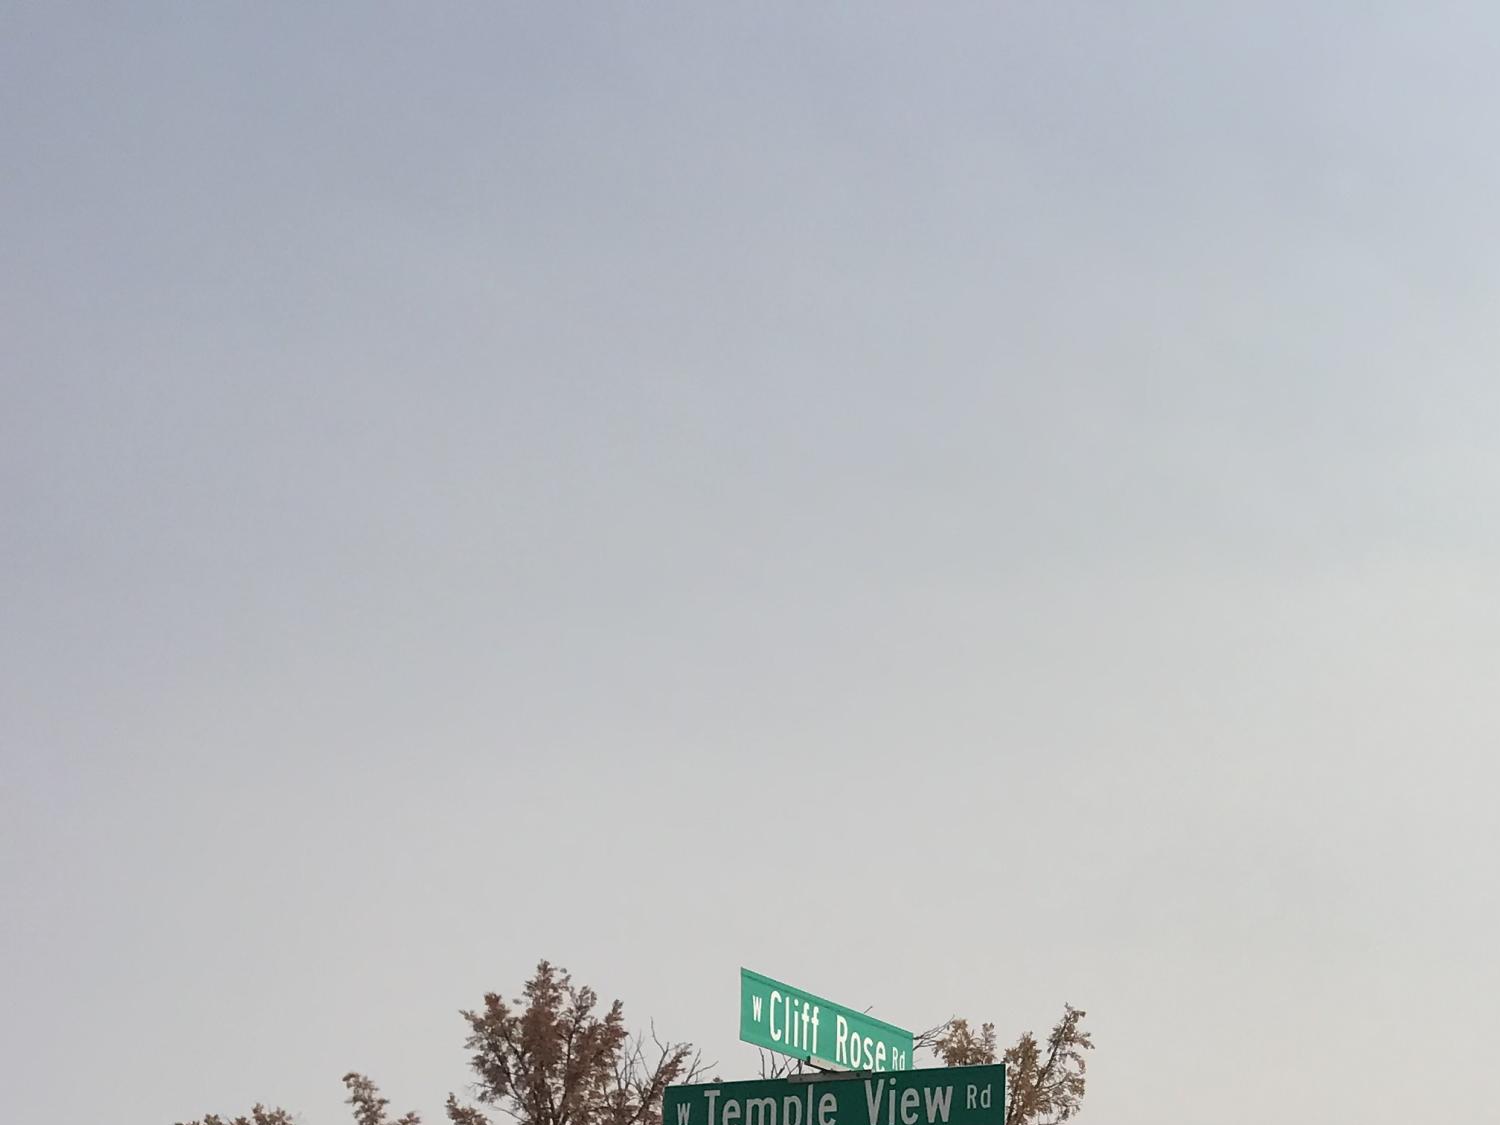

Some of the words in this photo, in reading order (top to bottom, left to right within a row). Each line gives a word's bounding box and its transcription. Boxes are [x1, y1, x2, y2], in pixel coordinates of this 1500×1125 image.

[752, 994, 762, 1023] W
[769, 990, 820, 1055] Cliff
[835, 1014, 887, 1073] Rose
[892, 1046, 906, 1071] Rd
[966, 1083, 992, 1109] Rd
